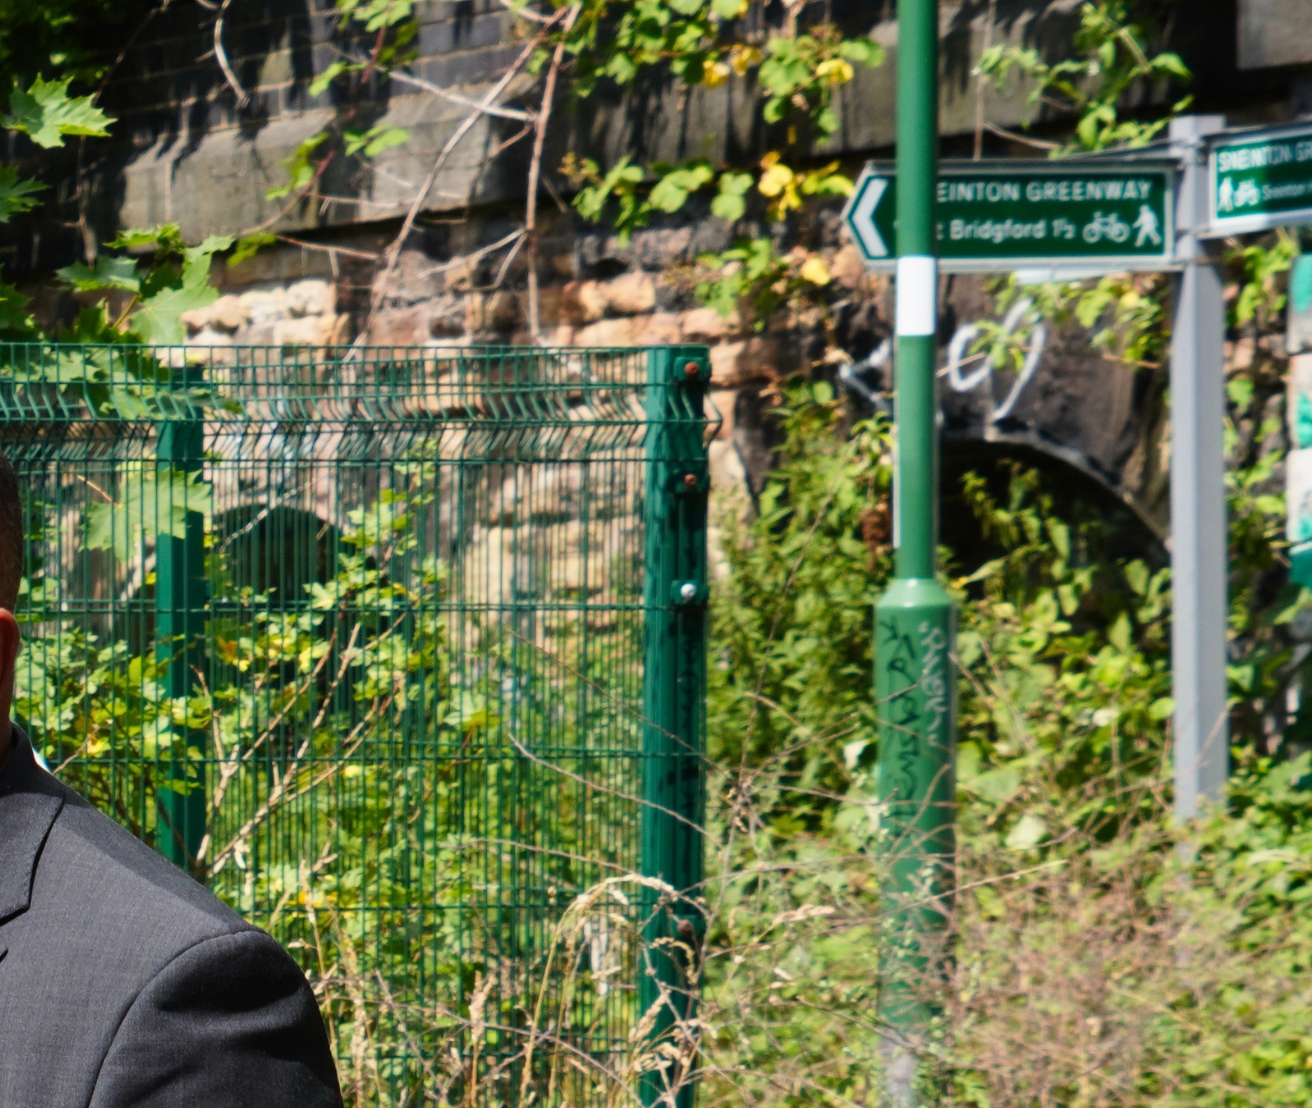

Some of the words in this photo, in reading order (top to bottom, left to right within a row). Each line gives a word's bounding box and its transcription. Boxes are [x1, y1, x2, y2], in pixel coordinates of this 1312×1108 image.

[936, 182, 1020, 202] EINTON
[1026, 179, 1153, 202] GREENWAY
[949, 219, 1047, 244] Bridgford
